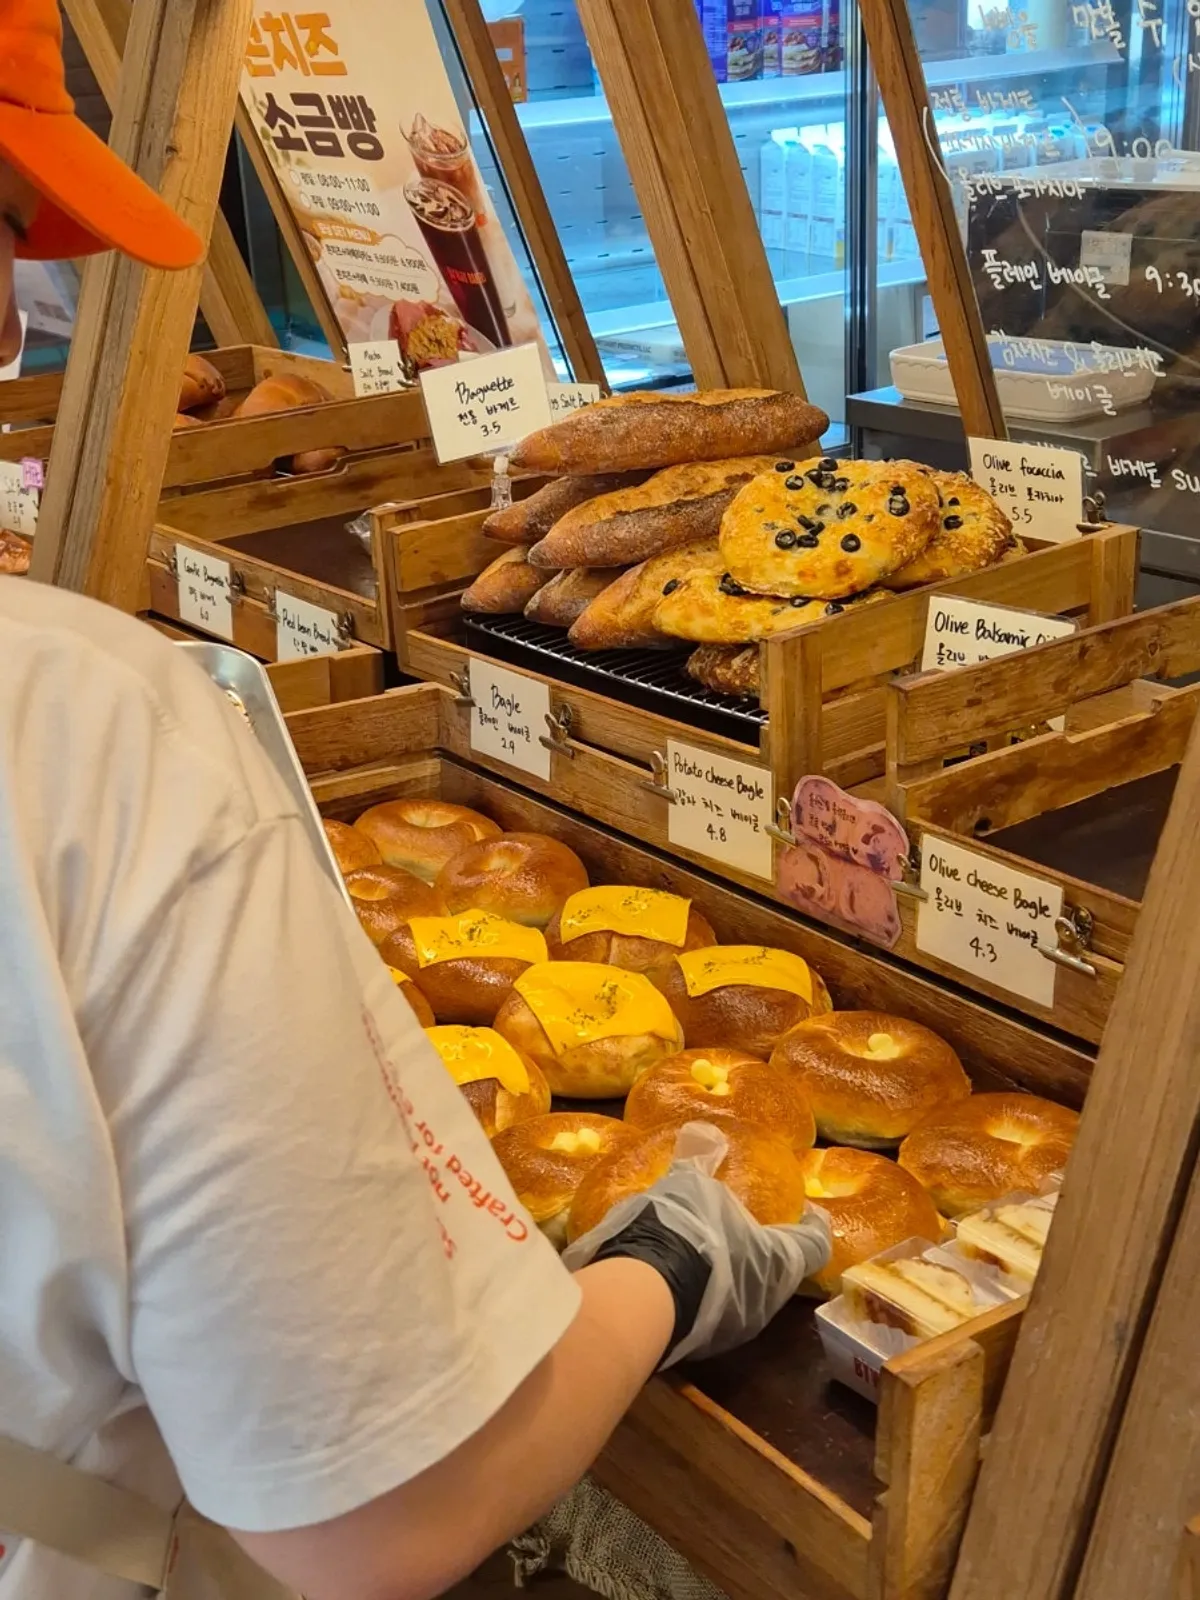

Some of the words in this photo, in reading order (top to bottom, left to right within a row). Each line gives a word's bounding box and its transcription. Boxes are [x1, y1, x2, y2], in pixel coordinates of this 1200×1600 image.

[264, 92, 385, 161] 소금빵
[981, 249, 1042, 290] 플레인
[1047, 261, 1111, 299] 베이글
[455, 376, 516, 405] Baguette
[1048, 381, 1117, 416] 베이글
[486, 397, 520, 416] 바게트
[480, 421, 502, 437] 3.5
[983, 454, 1013, 472] Olive
[1107, 454, 1162, 488] 바게트
[989, 478, 1017, 497] 올리브
[1011, 507, 1033, 524] 5.5
[934, 610, 969, 635] Olive
[936, 642, 968, 666] 올리브
[491, 683, 521, 716] Bagle
[674, 752, 703, 778] Potato
[701, 797, 725, 817] 치즈
[730, 808, 760, 832] 베이글
[706, 823, 727, 842] 4.8
[929, 854, 961, 881] Olive
[1013, 888, 1051, 919] Bagle
[935, 887, 963, 916] 올리브
[976, 909, 999, 930] 치즈
[969, 937, 997, 962] 4.3
[445, 1154, 528, 1242] Crafted
